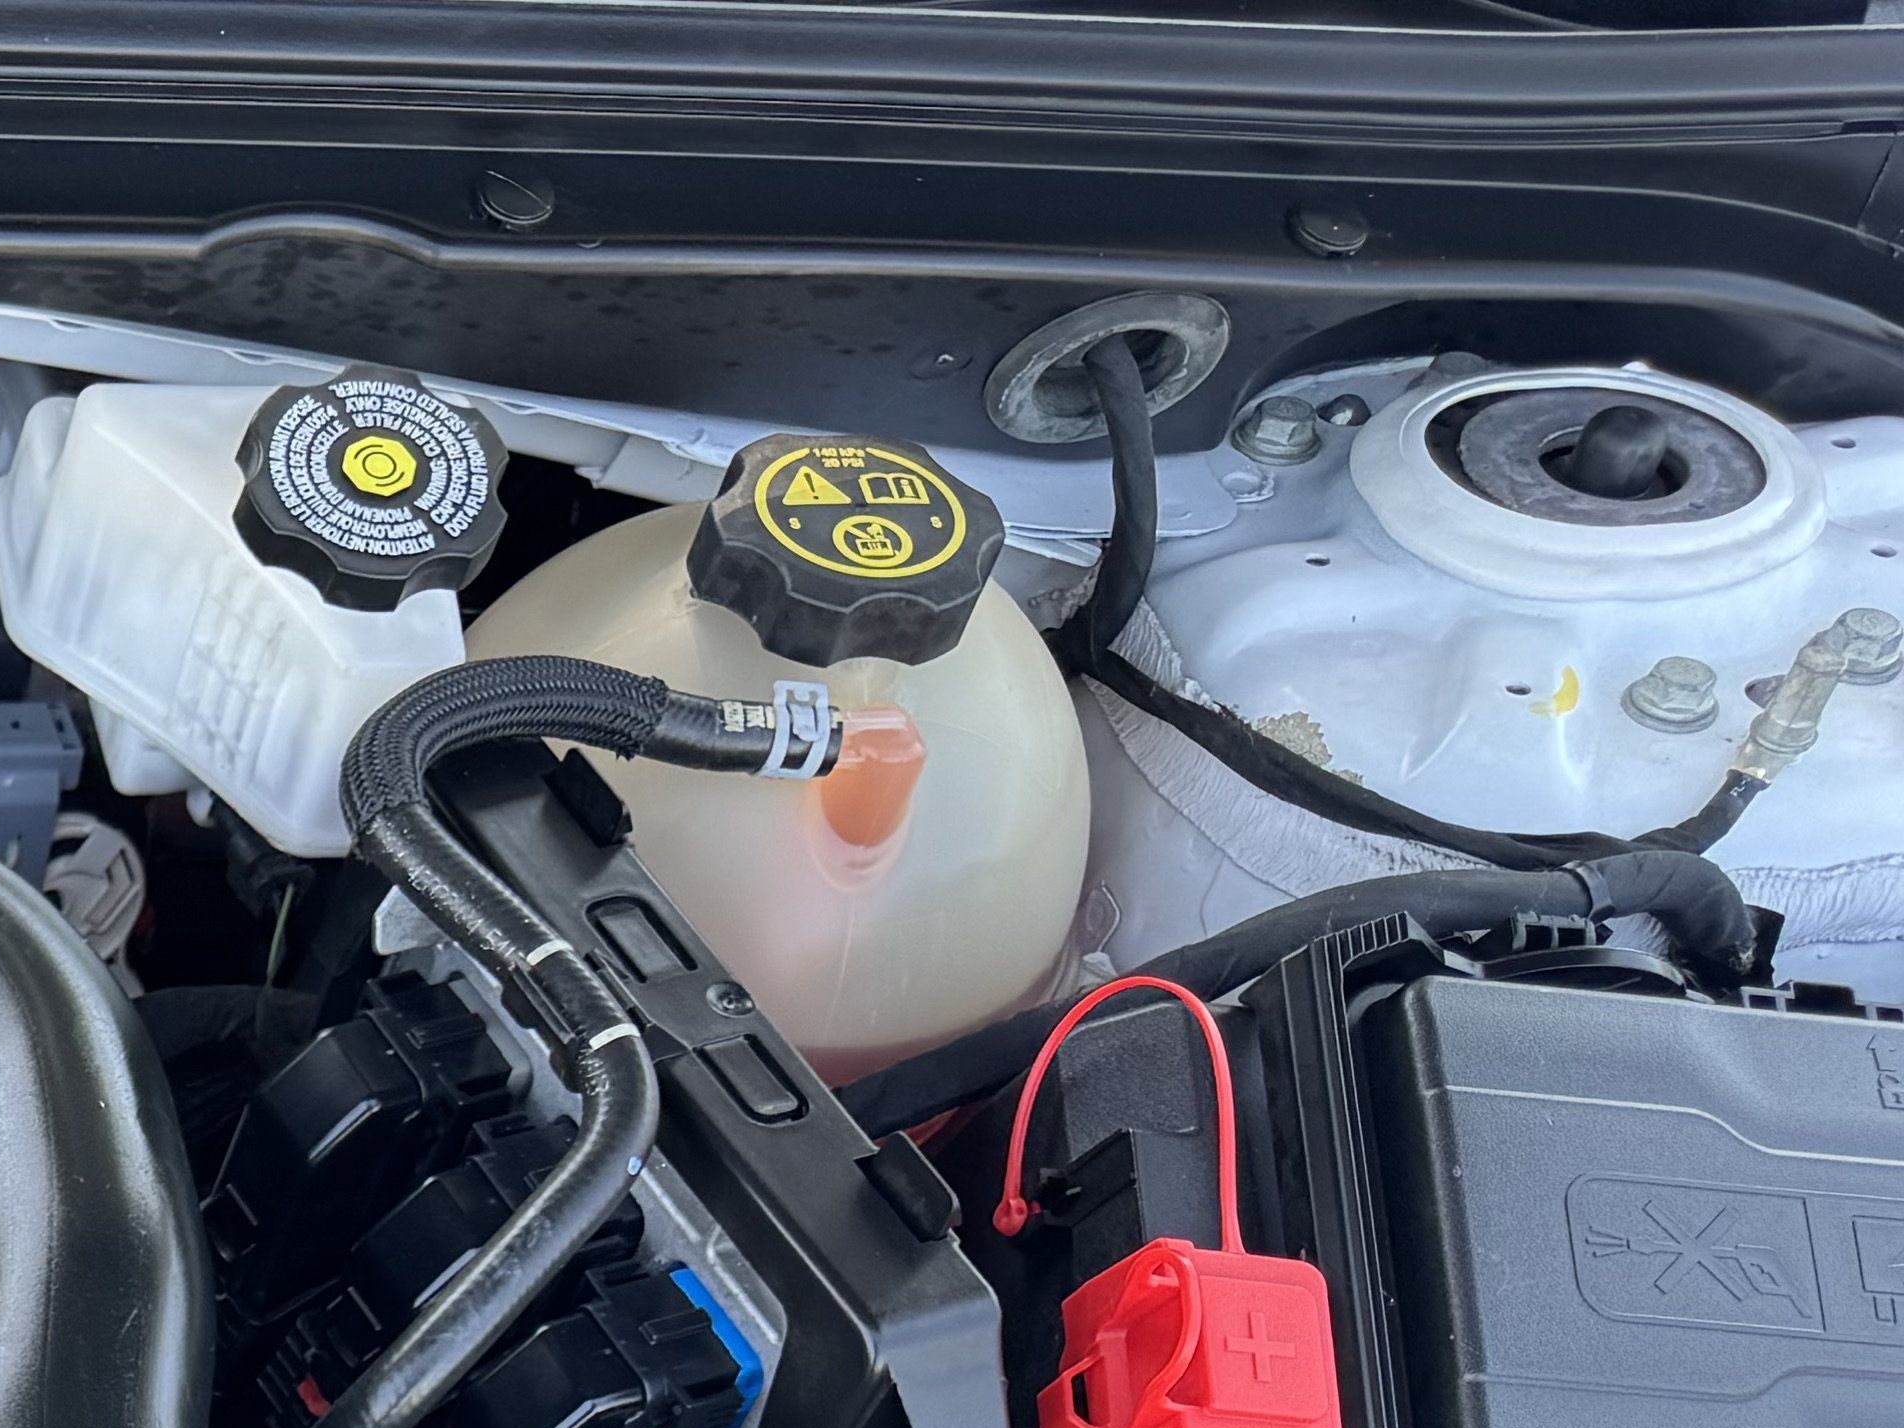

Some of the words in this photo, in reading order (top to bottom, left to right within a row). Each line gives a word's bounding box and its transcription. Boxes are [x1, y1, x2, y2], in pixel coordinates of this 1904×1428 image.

[340, 397, 382, 414] ONLY
[351, 413, 403, 431] FILLER
[414, 392, 469, 433] SEALED
[269, 425, 294, 462] AVANT
[291, 424, 318, 454] FREIN
[311, 419, 350, 455] SCELLE
[399, 420, 443, 457] CLEAN
[460, 437, 488, 473] FROM
[269, 462, 302, 508] BOUCHON
[290, 466, 322, 504] LIQUIDE
[309, 452, 331, 484] BIDON
[444, 458, 468, 504] BEFORE
[464, 474, 488, 510] FLUID
[323, 508, 354, 531] QUE
[336, 498, 415, 524] PROVENANT
[427, 498, 460, 525] CAP
[442, 509, 476, 538] DOT
[301, 514, 366, 553] NETTOYER
